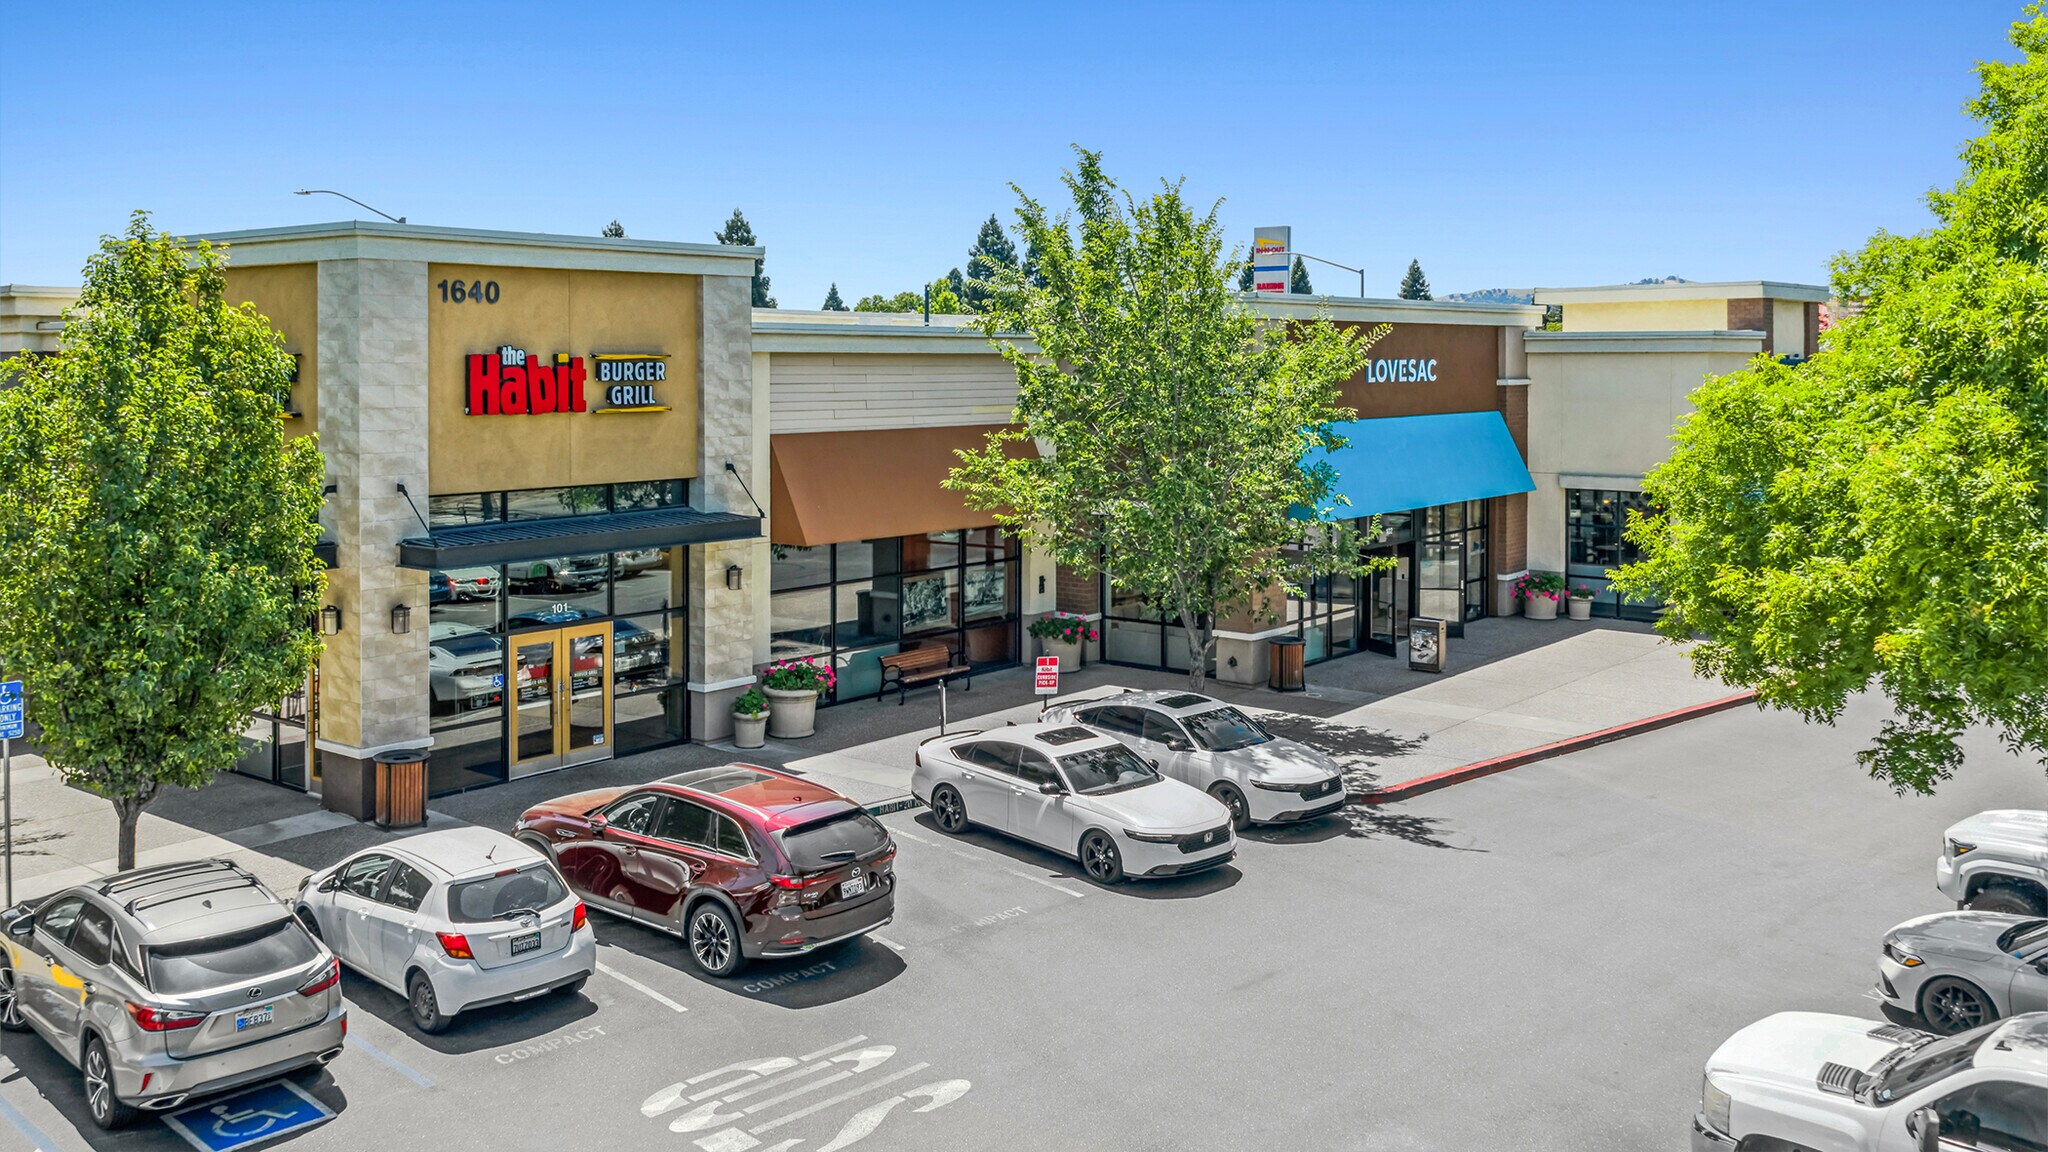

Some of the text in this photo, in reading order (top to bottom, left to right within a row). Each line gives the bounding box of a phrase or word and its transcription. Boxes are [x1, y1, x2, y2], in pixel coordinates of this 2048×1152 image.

[437, 279, 500, 304] 1640
[501, 345, 526, 366] the
[599, 362, 666, 381] BURGER
[1367, 358, 1438, 383] LOVESAC
[467, 353, 587, 415] Habit
[610, 385, 656, 405] GRILL
[551, 602, 568, 614] 101
[0, 703, 22, 713] RKING
[743, 961, 837, 993] COMPACT
[494, 1025, 606, 1065] COMPACT
